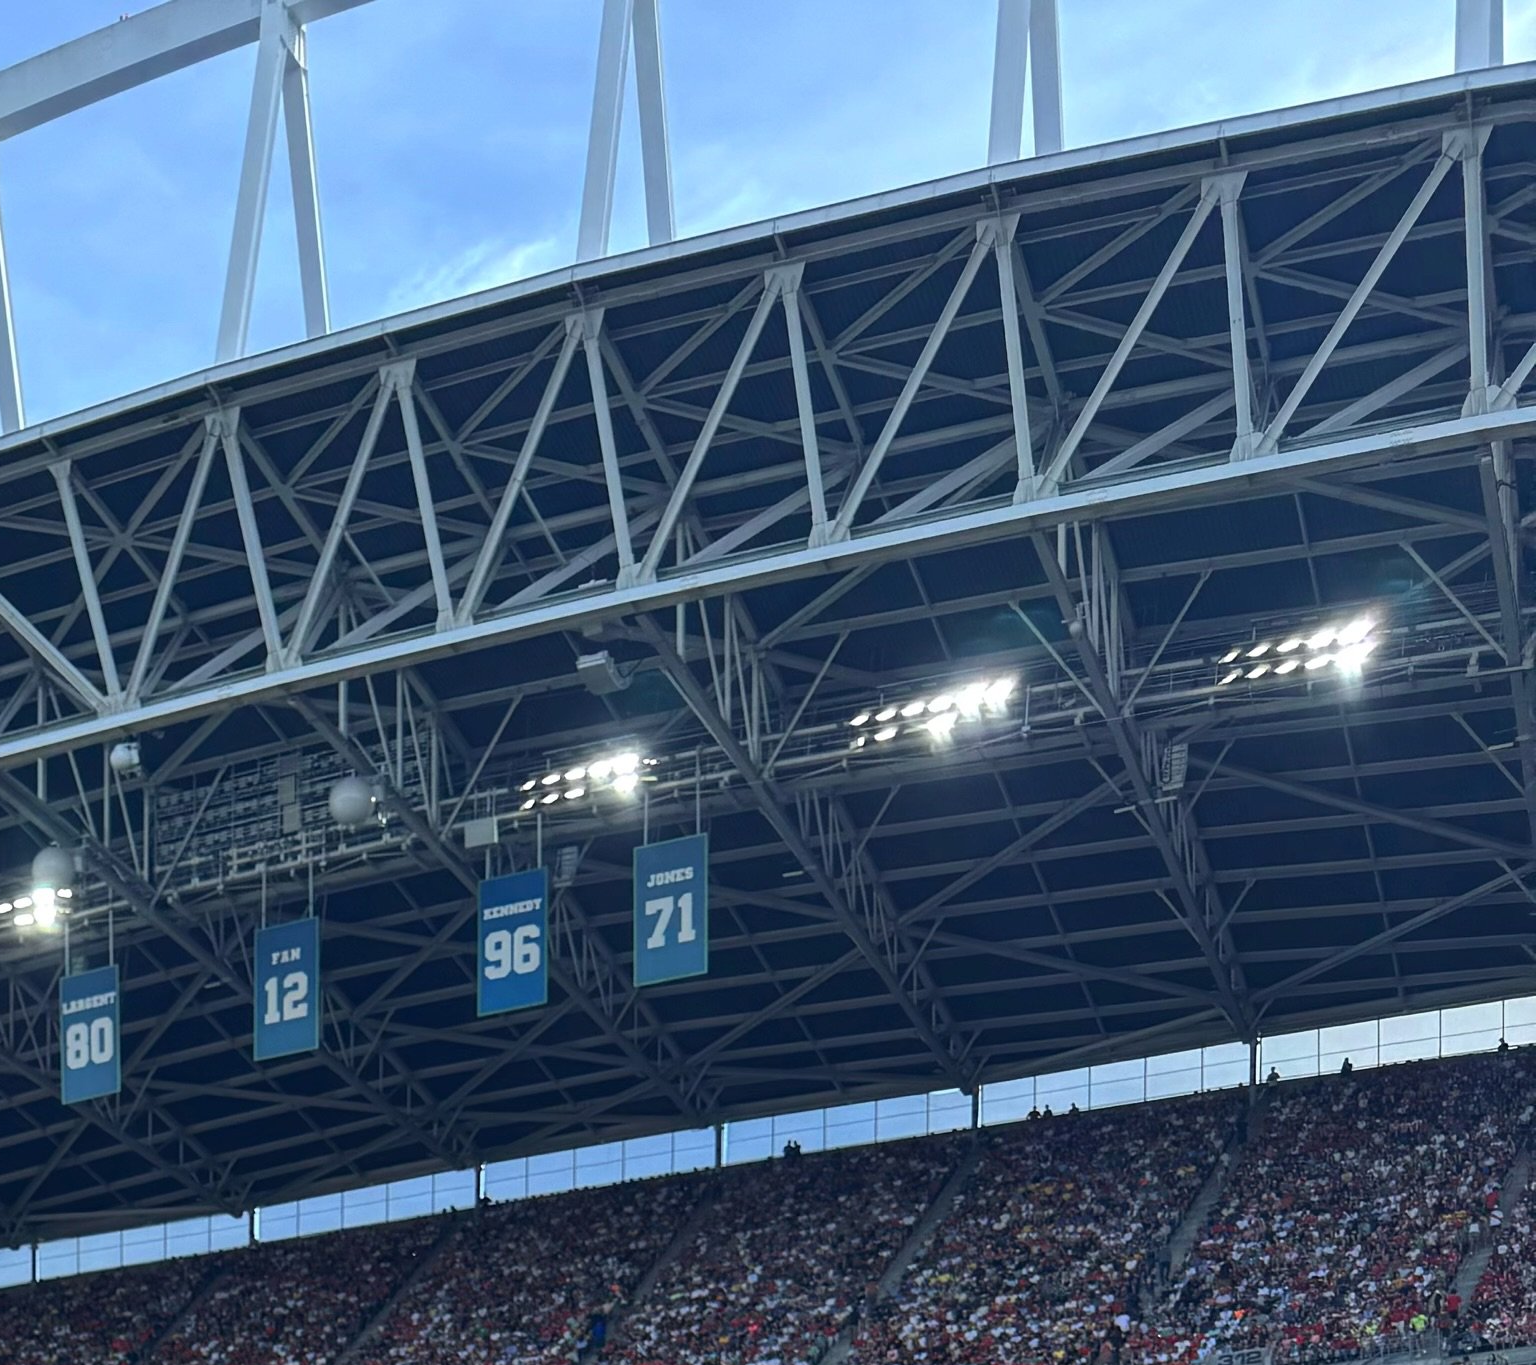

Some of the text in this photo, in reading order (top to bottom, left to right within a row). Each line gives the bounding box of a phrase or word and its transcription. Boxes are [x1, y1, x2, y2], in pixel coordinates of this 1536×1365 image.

[647, 866, 694, 888] JONES
[645, 892, 696, 949] 71
[271, 947, 302, 966] FAN
[484, 924, 541, 980] 96
[264, 971, 308, 1025] 12
[66, 1016, 114, 1070] 80
